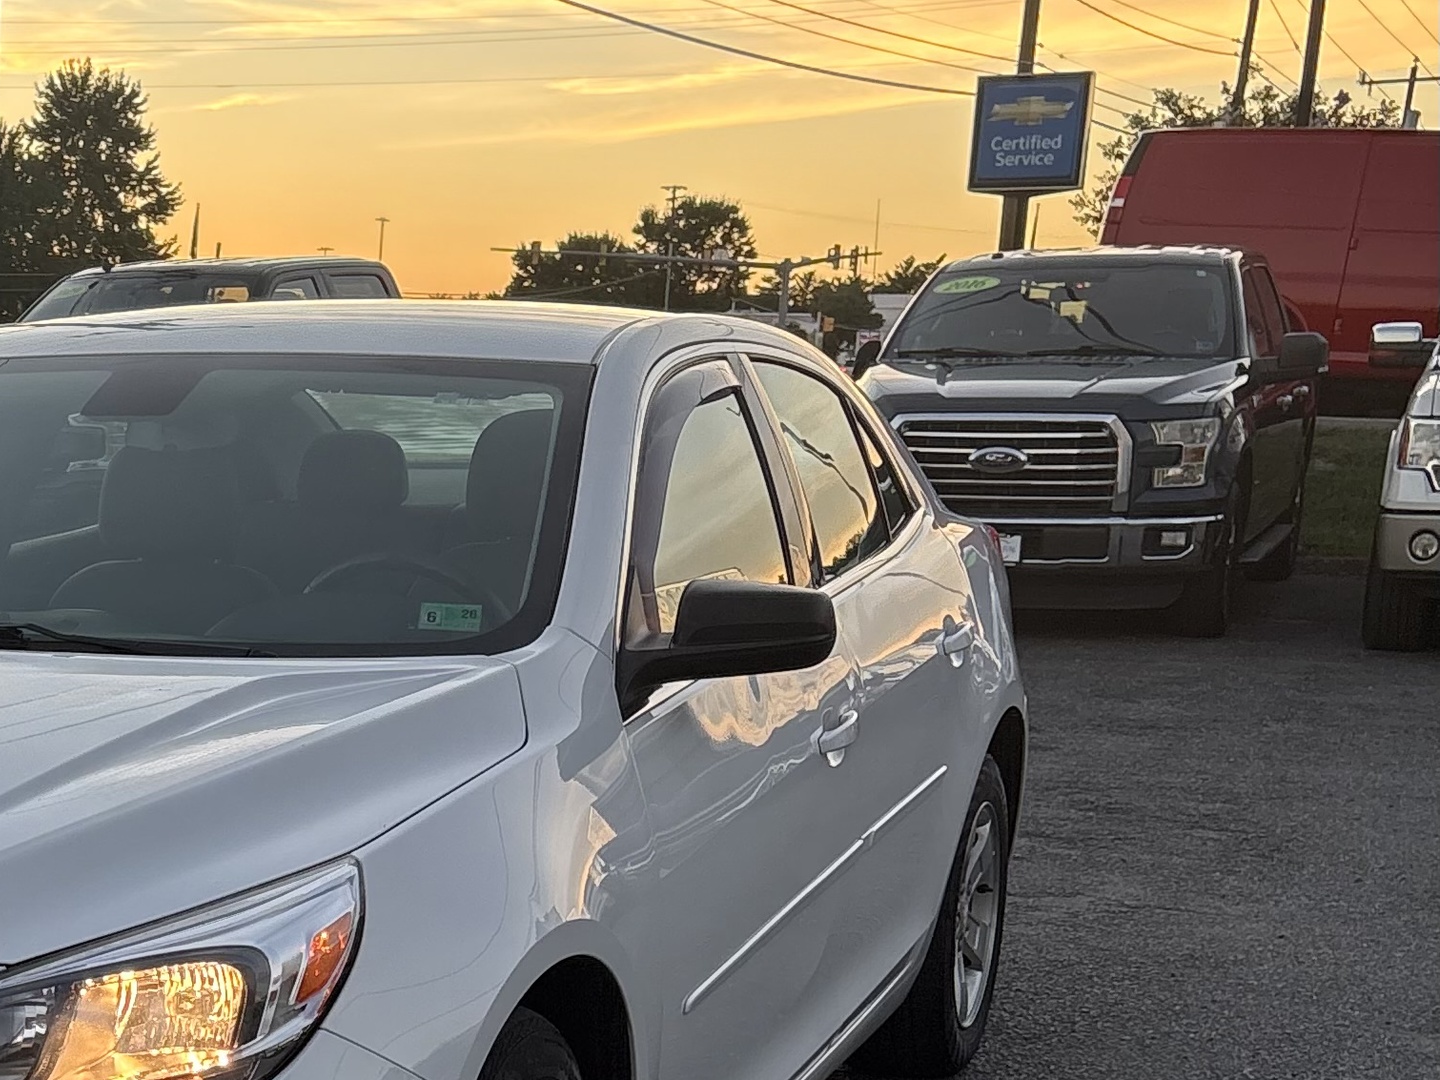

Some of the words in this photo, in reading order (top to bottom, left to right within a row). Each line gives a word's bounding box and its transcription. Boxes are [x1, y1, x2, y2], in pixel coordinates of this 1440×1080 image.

[990, 133, 1063, 151] Certified
[994, 151, 1055, 167] Service
[426, 611, 437, 623] 6
